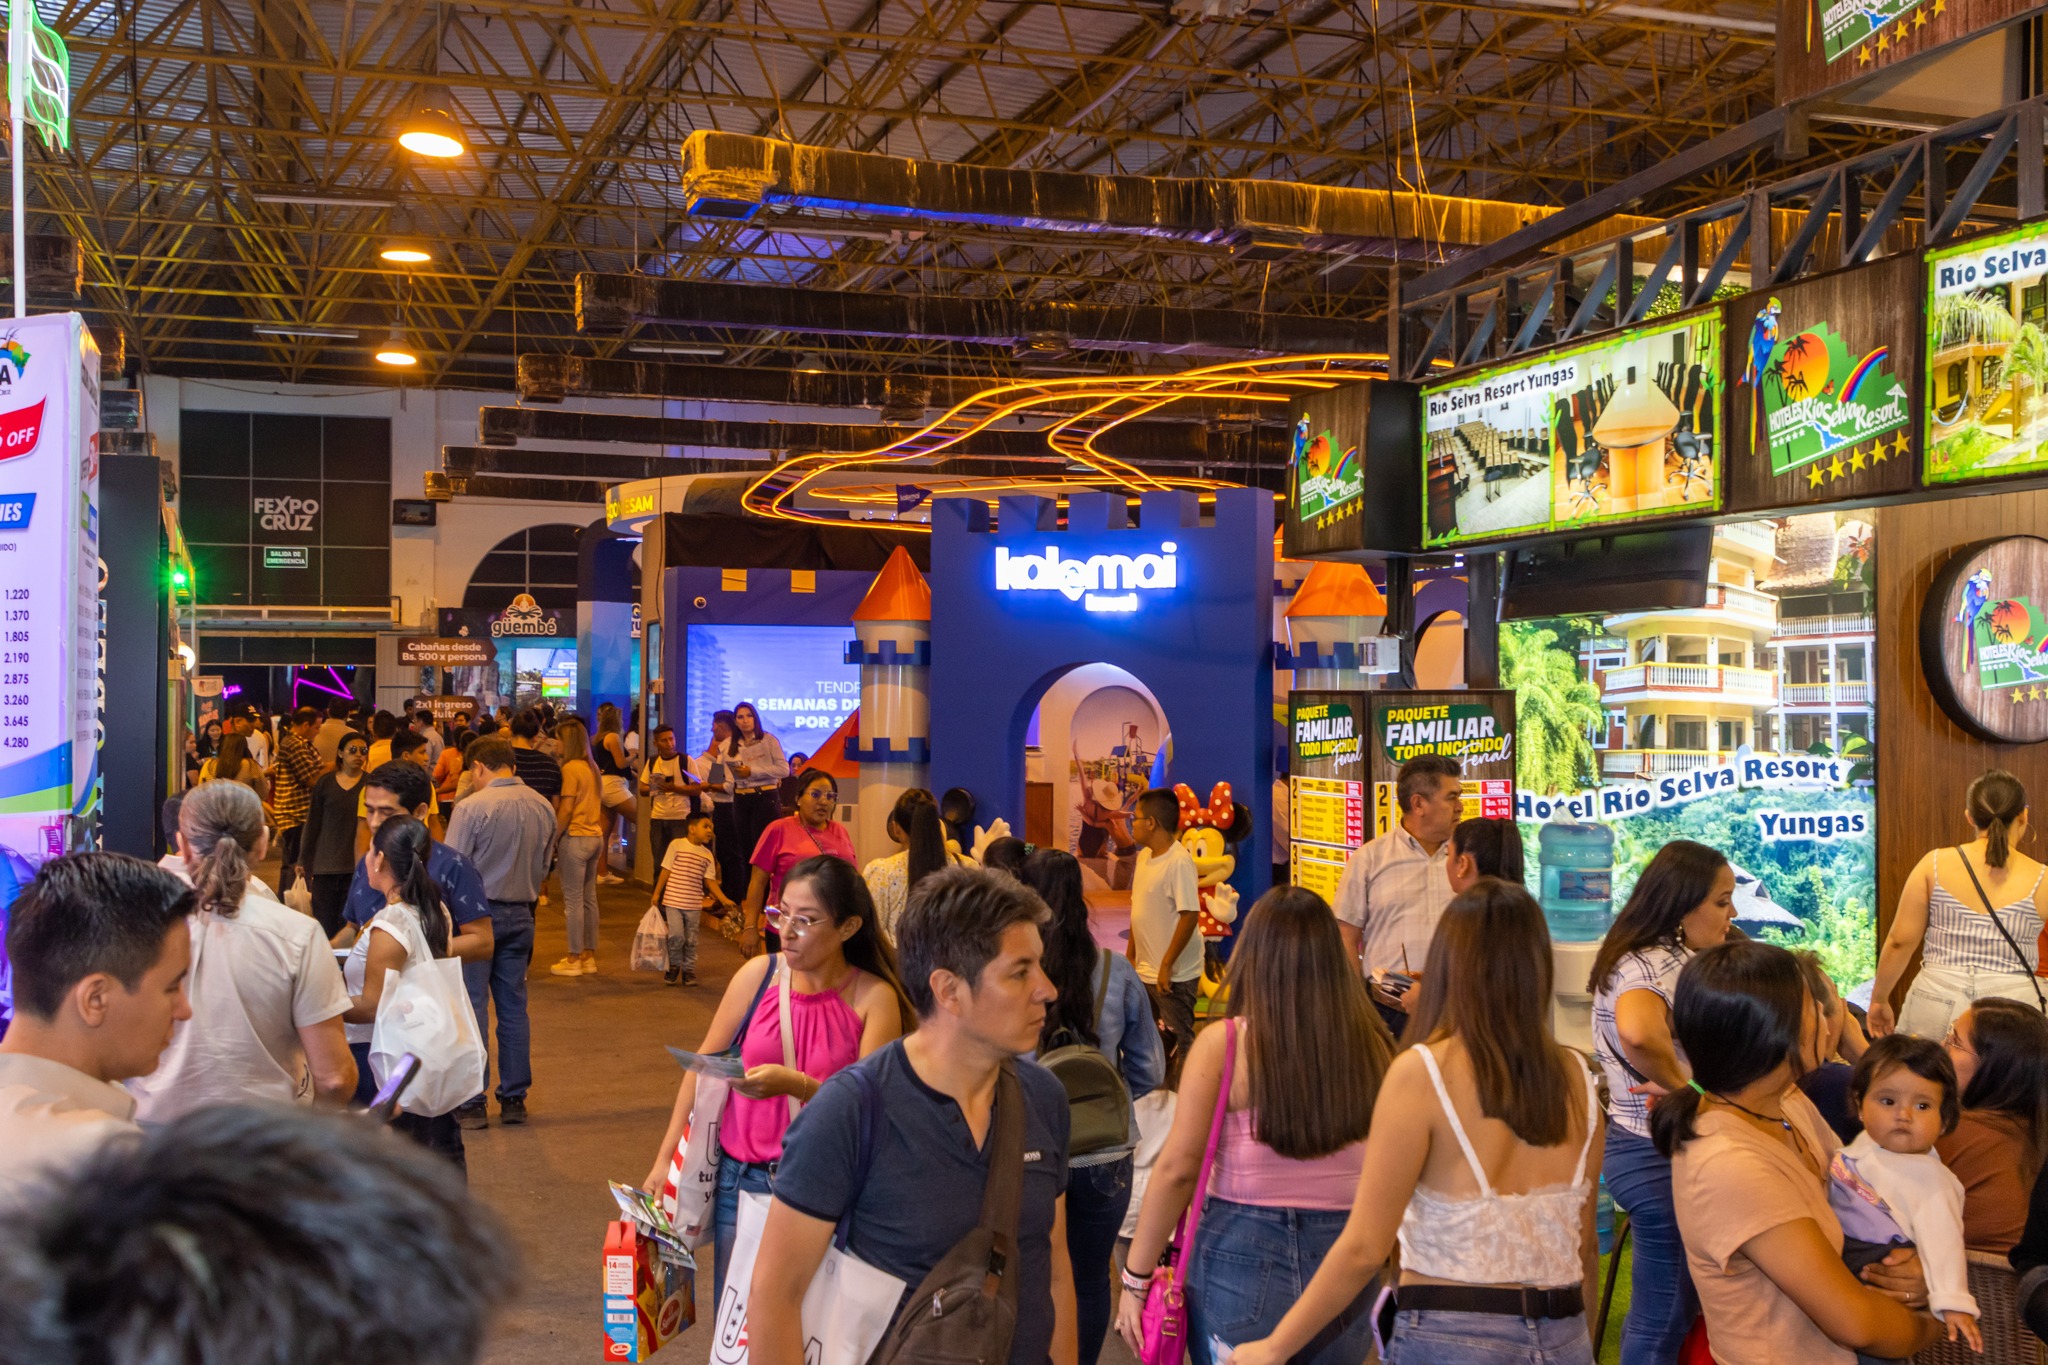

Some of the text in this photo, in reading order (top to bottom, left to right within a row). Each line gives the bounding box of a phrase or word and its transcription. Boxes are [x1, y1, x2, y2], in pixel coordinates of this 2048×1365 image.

[1941, 248, 2046, 289] Río Selva
[1451, 393, 1480, 411] Selva
[1485, 379, 1525, 402] Resort
[1527, 366, 1574, 390] Yungas
[1769, 402, 1803, 432] HOTELES
[1822, 400, 1858, 428] Selva
[7, 426, 35, 447] OFF
[254, 496, 319, 515] FEXPO
[260, 514, 313, 531] CRUZ
[4, 589, 29, 600] 1.220
[4, 610, 29, 621] 1.370
[492, 618, 557, 637] güembé
[4, 631, 29, 642] 1.805
[407, 642, 481, 651] Cabañas desde
[4, 653, 29, 664] 2.190
[418, 653, 438, 661] 500
[447, 654, 487, 662] persona
[4, 674, 29, 685] 2.875
[4, 695, 29, 706] 3.260
[434, 700, 473, 710] ingreso
[758, 698, 837, 711] SEMANAS
[4, 716, 29, 727] 3.645
[1296, 704, 1328, 722] PAQUETE
[1387, 705, 1449, 722] PAQUETE
[795, 716, 830, 728] POR
[1296, 716, 1353, 743] FAMILIAR
[1385, 716, 1495, 747] FAMILIAR
[4, 737, 29, 748] 4.280
[1299, 738, 1358, 756] TODO INCLUIDO
[1437, 737, 1504, 755] INCLUIDO
[1456, 733, 1512, 775] Ferial
[1379, 784, 1388, 807] 2
[1604, 788, 1650, 815] Río
[1660, 768, 1735, 802] Selva
[1744, 759, 1839, 782] Resort
[1760, 813, 1865, 838] Yungas
[699, 1171, 712, 1182] tu
